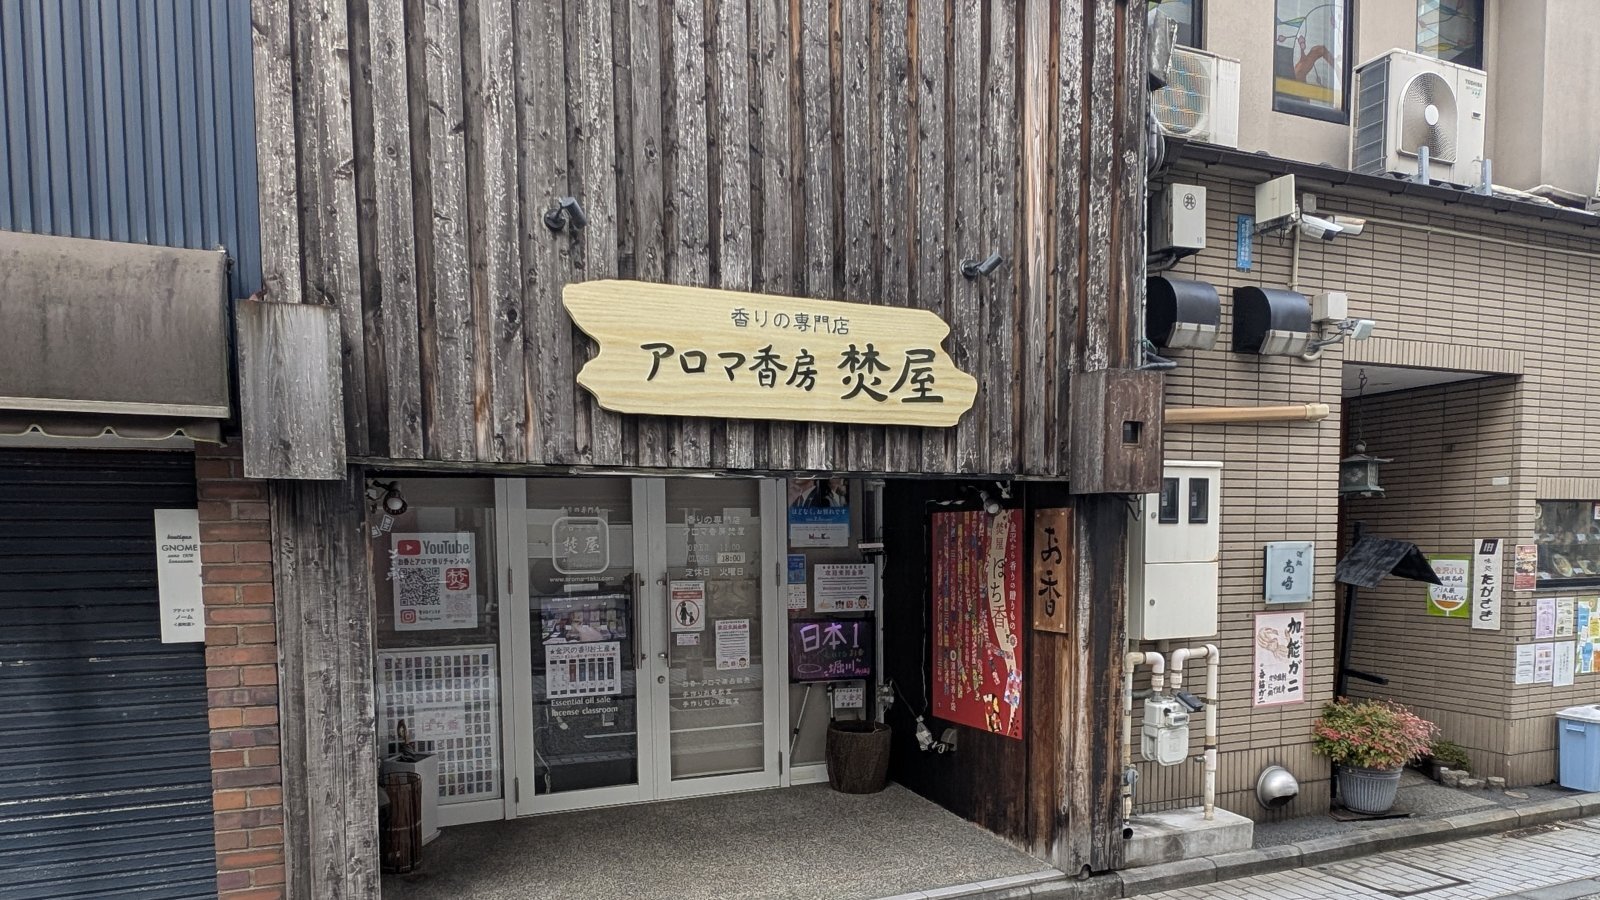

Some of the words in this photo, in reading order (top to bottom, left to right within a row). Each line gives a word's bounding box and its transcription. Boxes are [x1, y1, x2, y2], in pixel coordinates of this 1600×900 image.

[731, 307, 850, 336] 香りの専門店
[640, 343, 819, 392] アロマ香房
[837, 343, 945, 404] 焚屋
[422, 540, 470, 555] YouTube
[562, 536, 601, 554] 焚屋
[721, 554, 741, 563] 18:00
[685, 567, 711, 577] 定休日
[720, 567, 744, 576] 火曜日
[1038, 527, 1062, 617] お香
[1286, 617, 1303, 692] 加能ガニ
[551, 697, 583, 707] Essential
[585, 697, 596, 705] oil
[597, 696, 611, 704] sale
[551, 708, 579, 717] Incense
[582, 706, 618, 716] classroom
